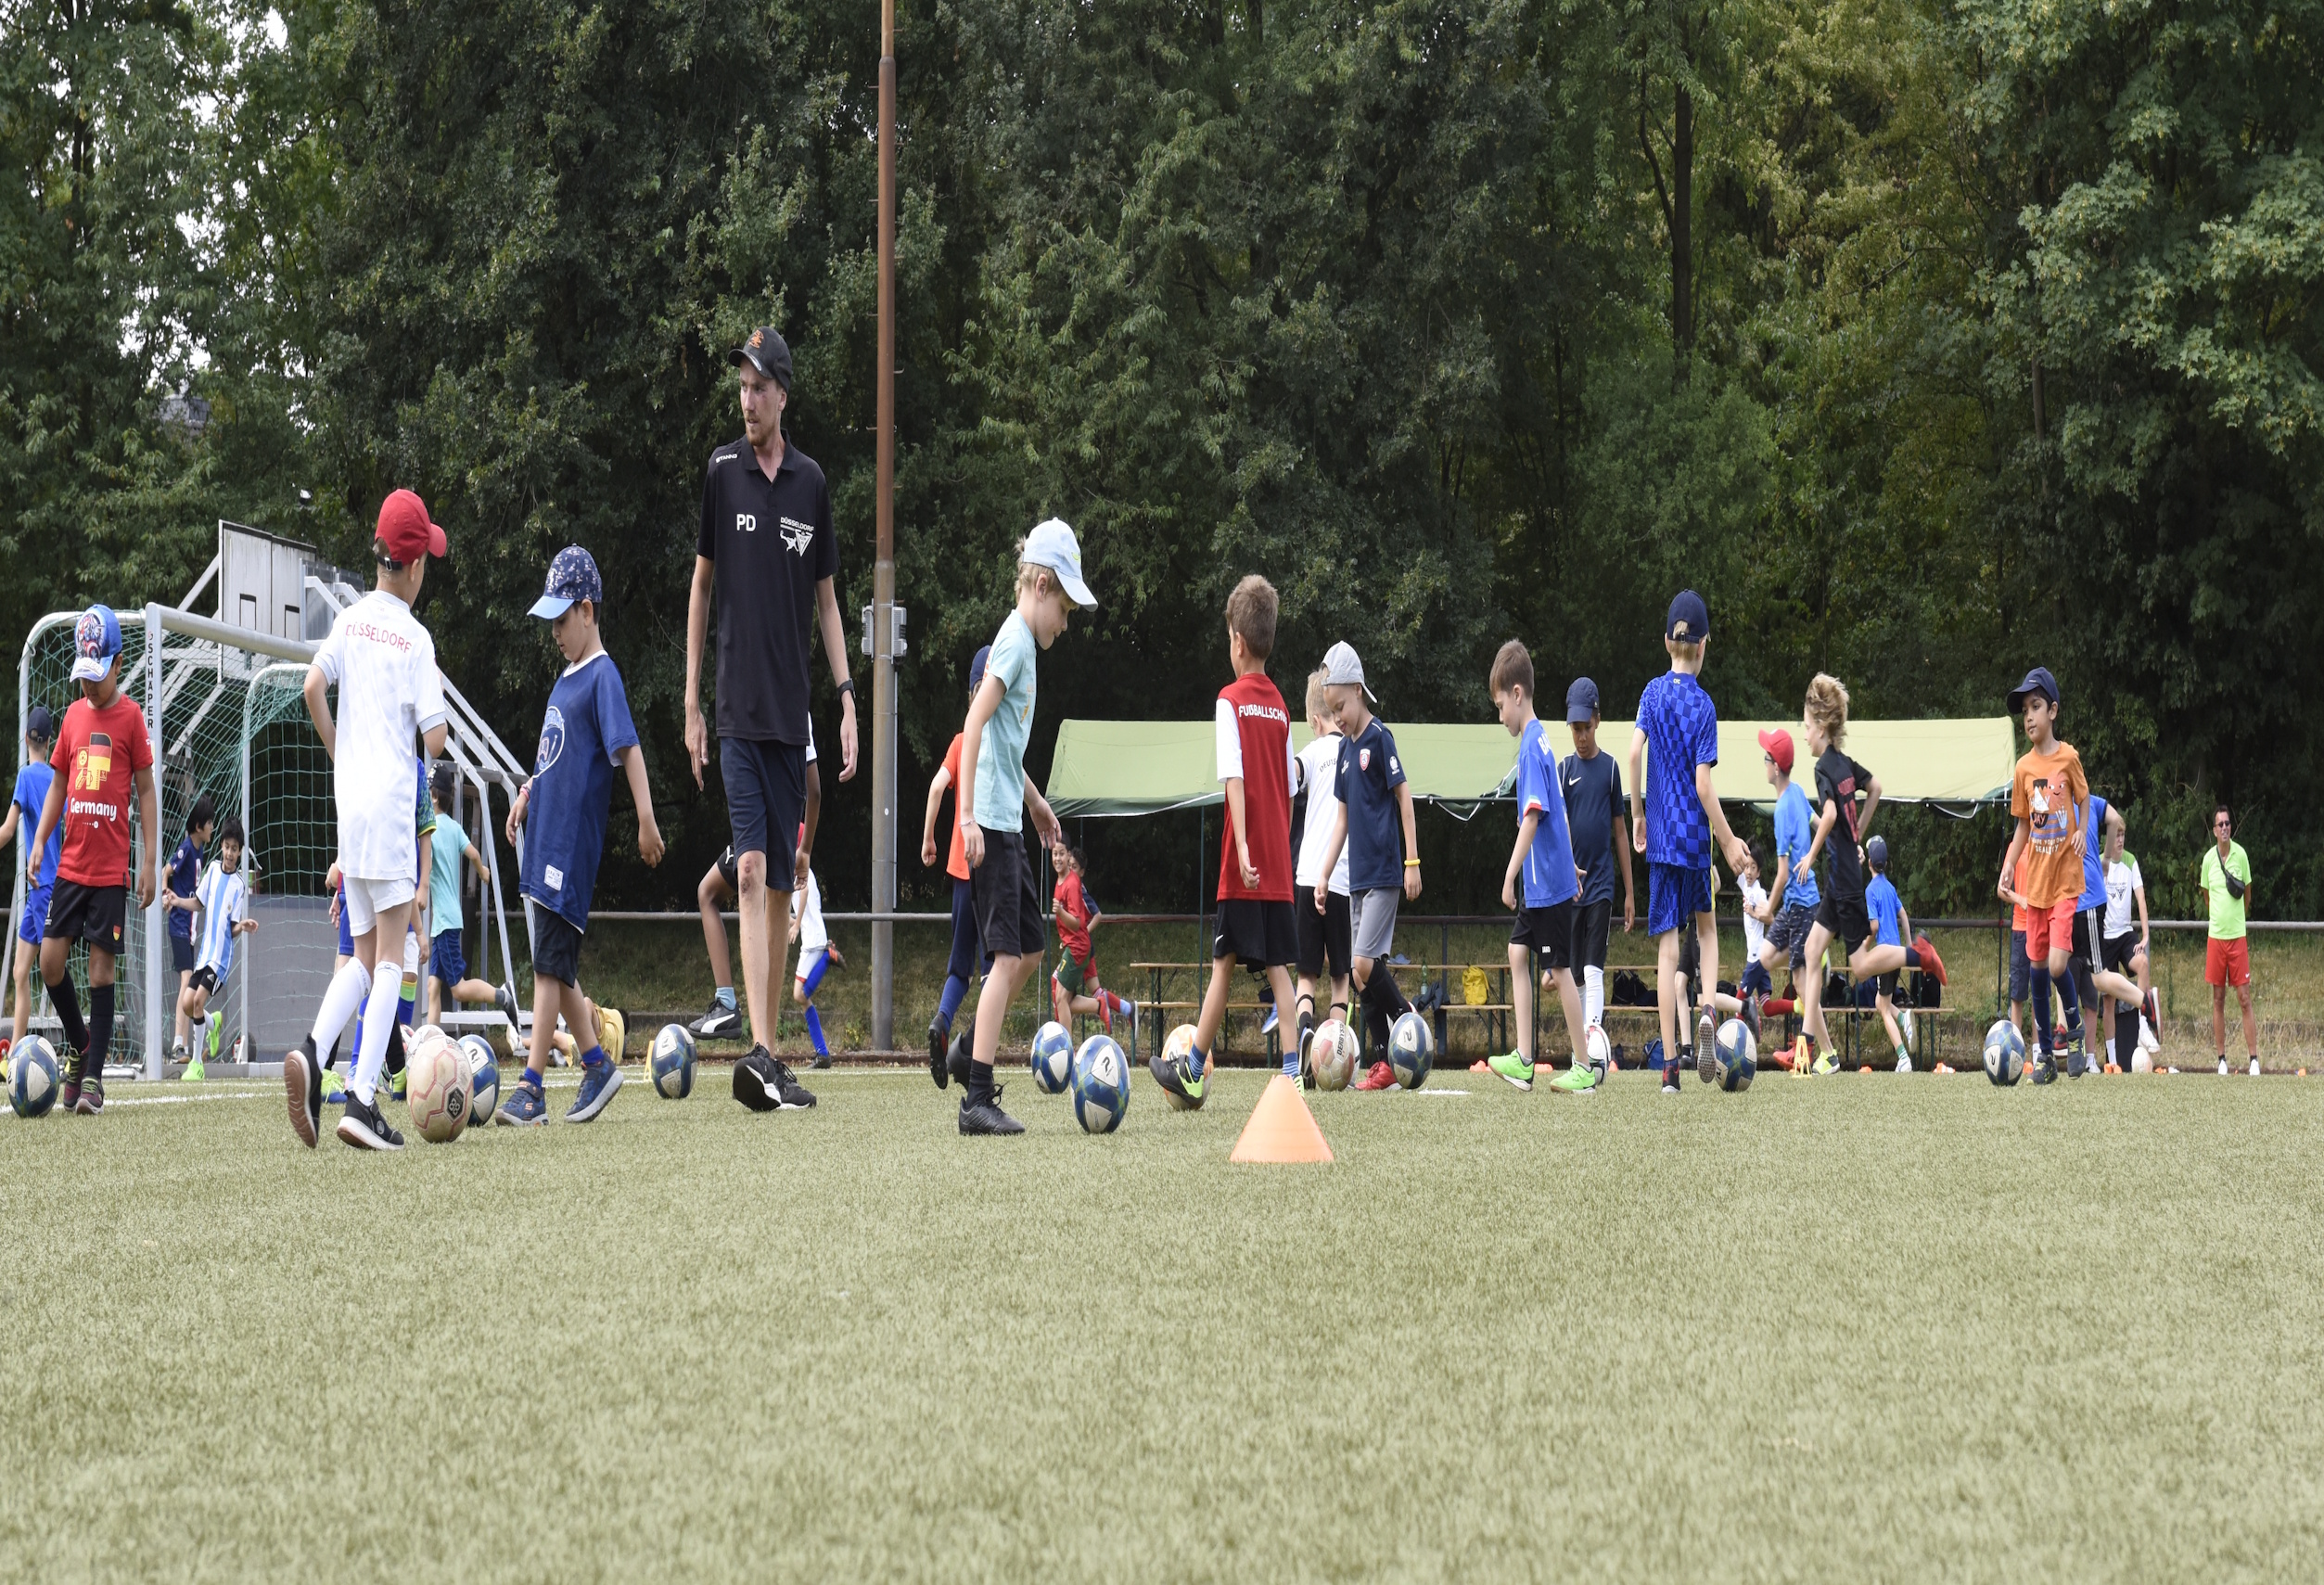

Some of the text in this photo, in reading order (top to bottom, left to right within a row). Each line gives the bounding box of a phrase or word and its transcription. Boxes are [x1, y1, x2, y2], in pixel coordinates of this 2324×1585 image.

[736, 514, 756, 531] PD
[780, 517, 814, 531] DÜSSELDORF
[70, 797, 117, 822] Germany
[1059, 958, 1066, 973] 7
